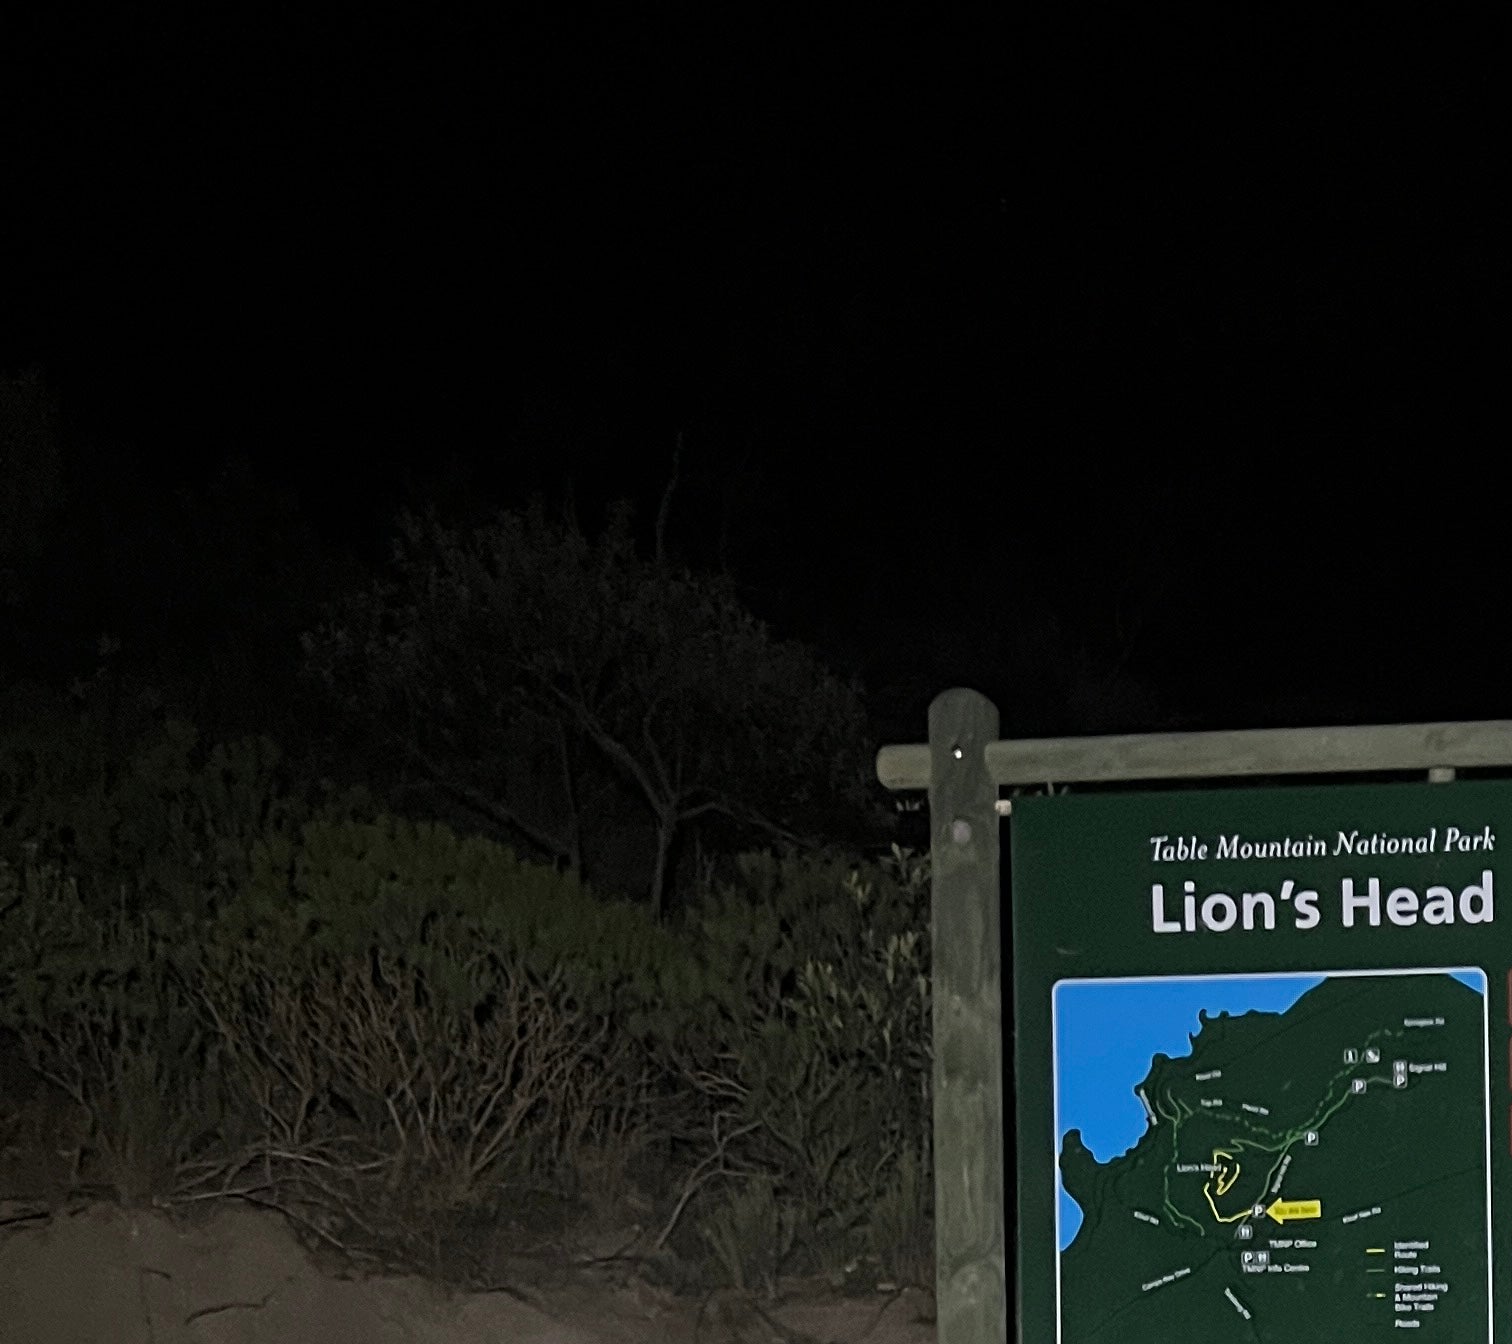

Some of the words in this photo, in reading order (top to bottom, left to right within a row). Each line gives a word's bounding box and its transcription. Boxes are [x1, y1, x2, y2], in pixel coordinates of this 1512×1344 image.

[1151, 836, 1207, 861] Table
[1216, 835, 1326, 859] Mountain
[1333, 828, 1436, 855] National
[1444, 826, 1495, 851] Park
[1153, 880, 1320, 932] Lion's
[1342, 870, 1493, 927] Head
